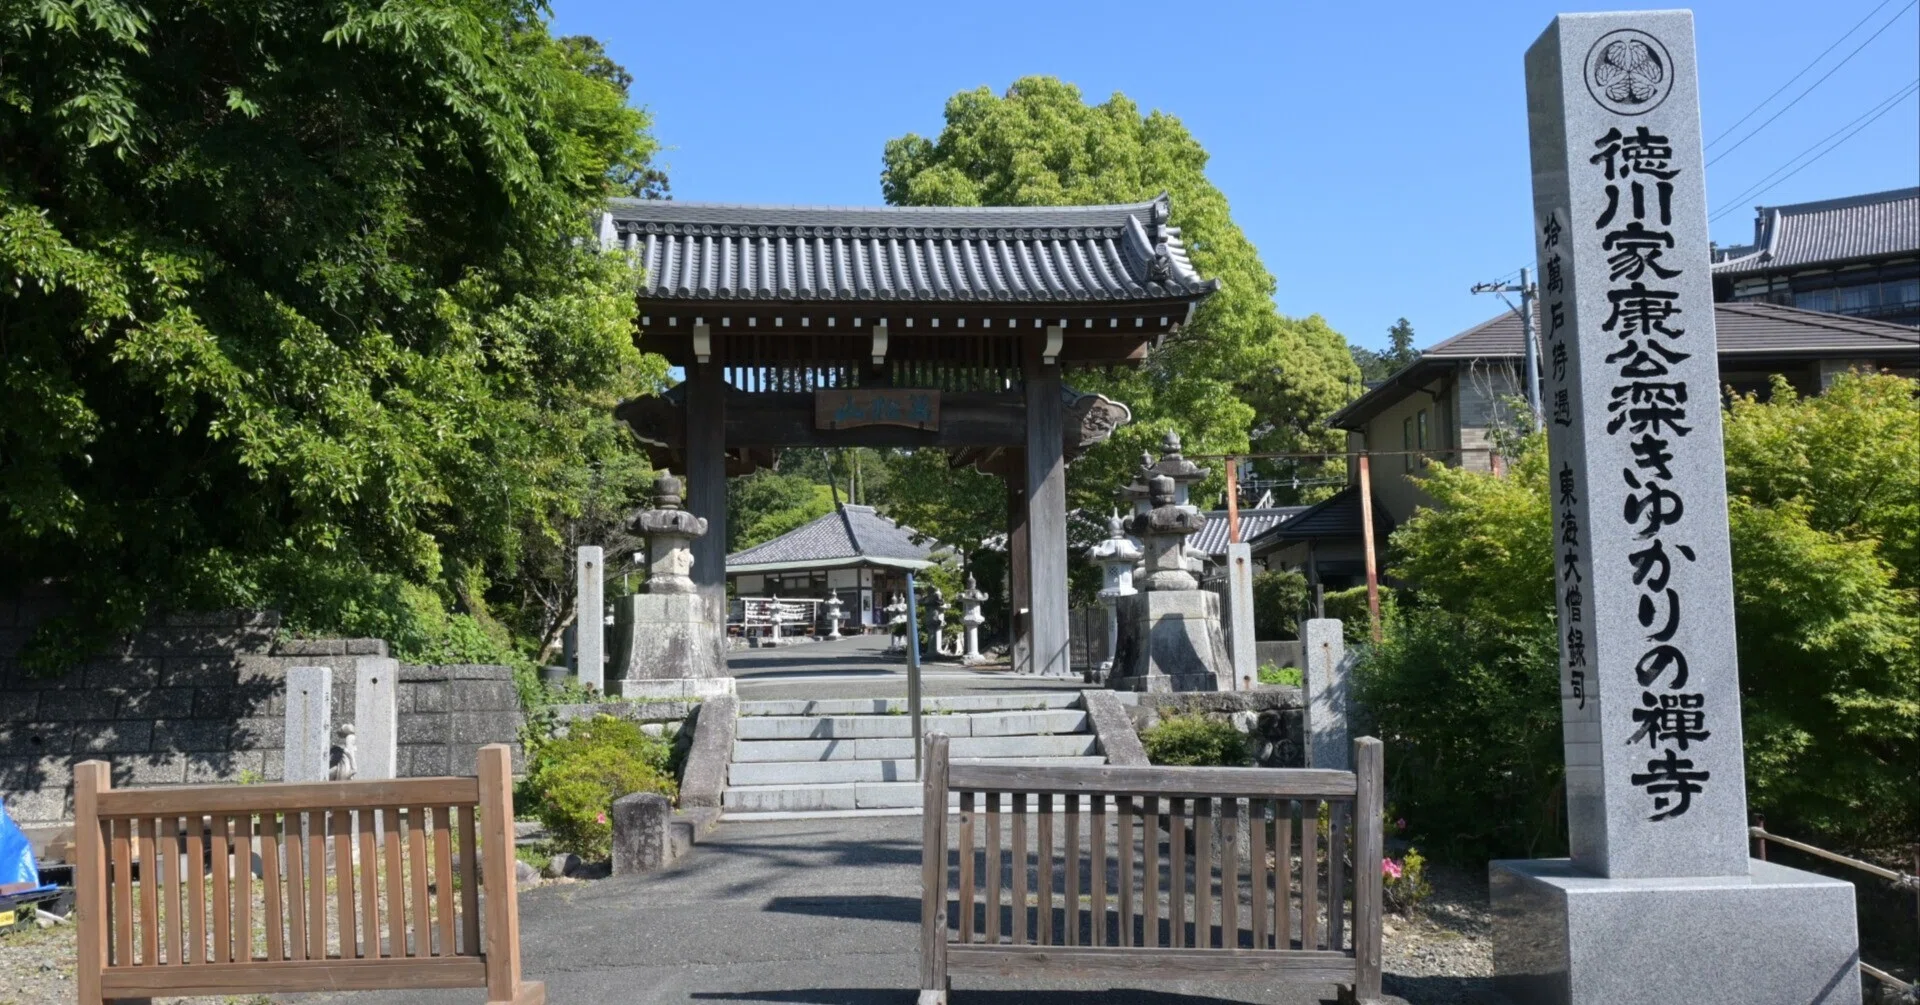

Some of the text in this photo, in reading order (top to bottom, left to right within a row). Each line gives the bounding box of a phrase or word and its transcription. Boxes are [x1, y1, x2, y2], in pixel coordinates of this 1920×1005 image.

[1544, 211, 1572, 427] 拾萬石待遇
[1590, 126, 1711, 822] 徳川家康公深きゆかりの禪寺
